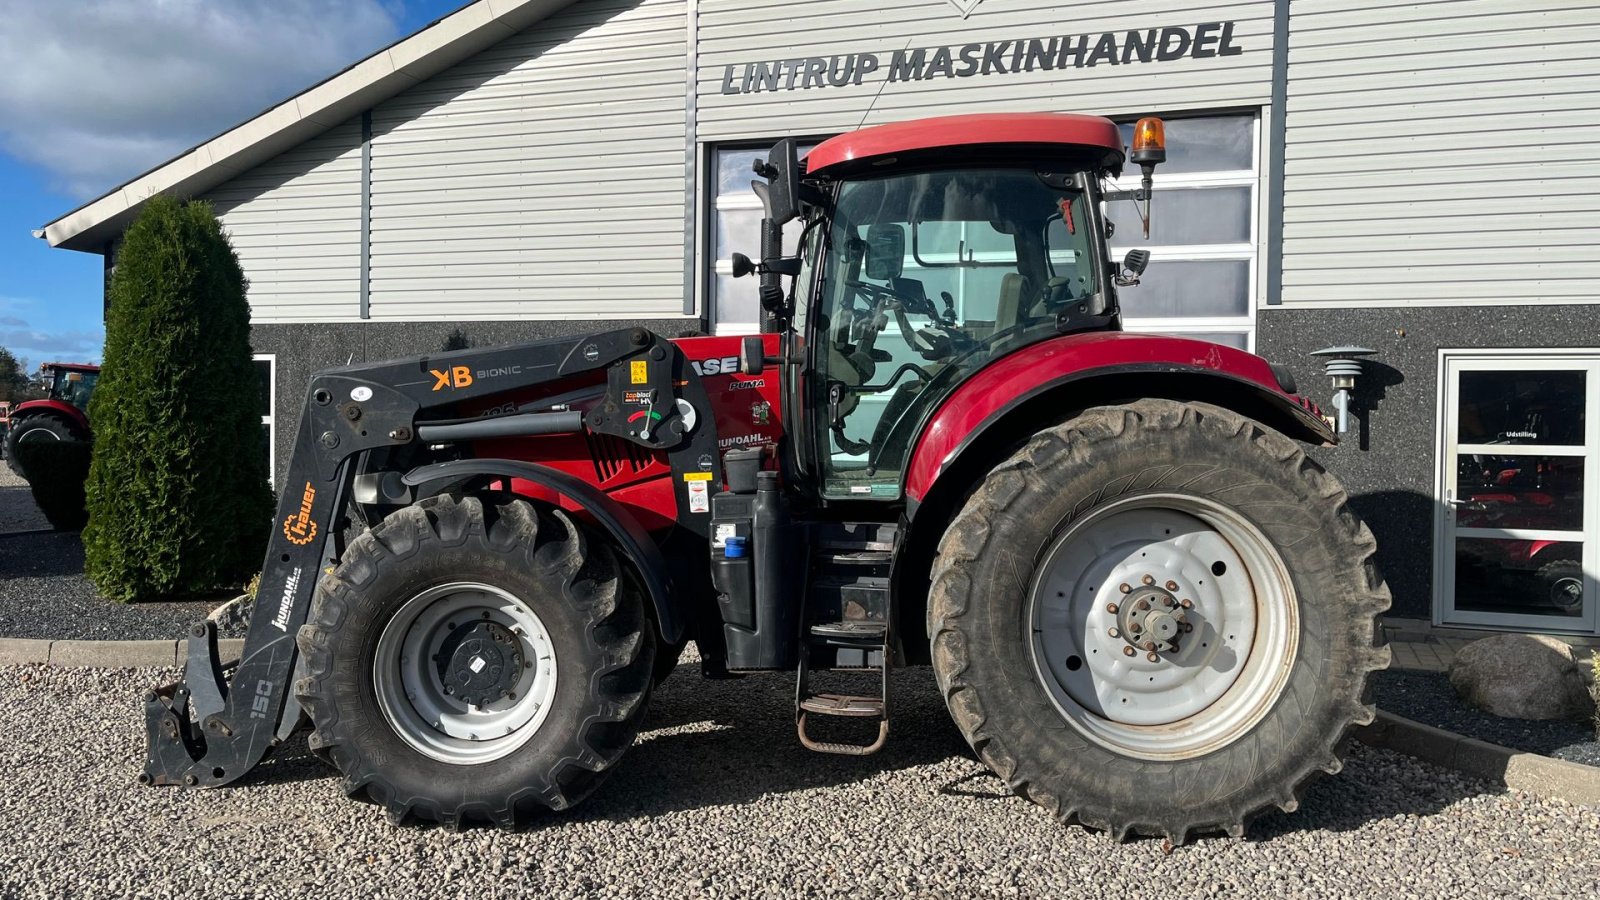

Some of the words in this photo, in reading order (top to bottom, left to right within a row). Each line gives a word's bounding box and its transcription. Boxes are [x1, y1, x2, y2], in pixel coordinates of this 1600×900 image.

[720, 53, 878, 94] LINTRUP
[888, 21, 1242, 82] MASKINHANDEL
[477, 365, 522, 379] BIONIC
[729, 379, 765, 391] PUMA
[291, 481, 316, 535] hauer
[250, 679, 273, 719] 150
